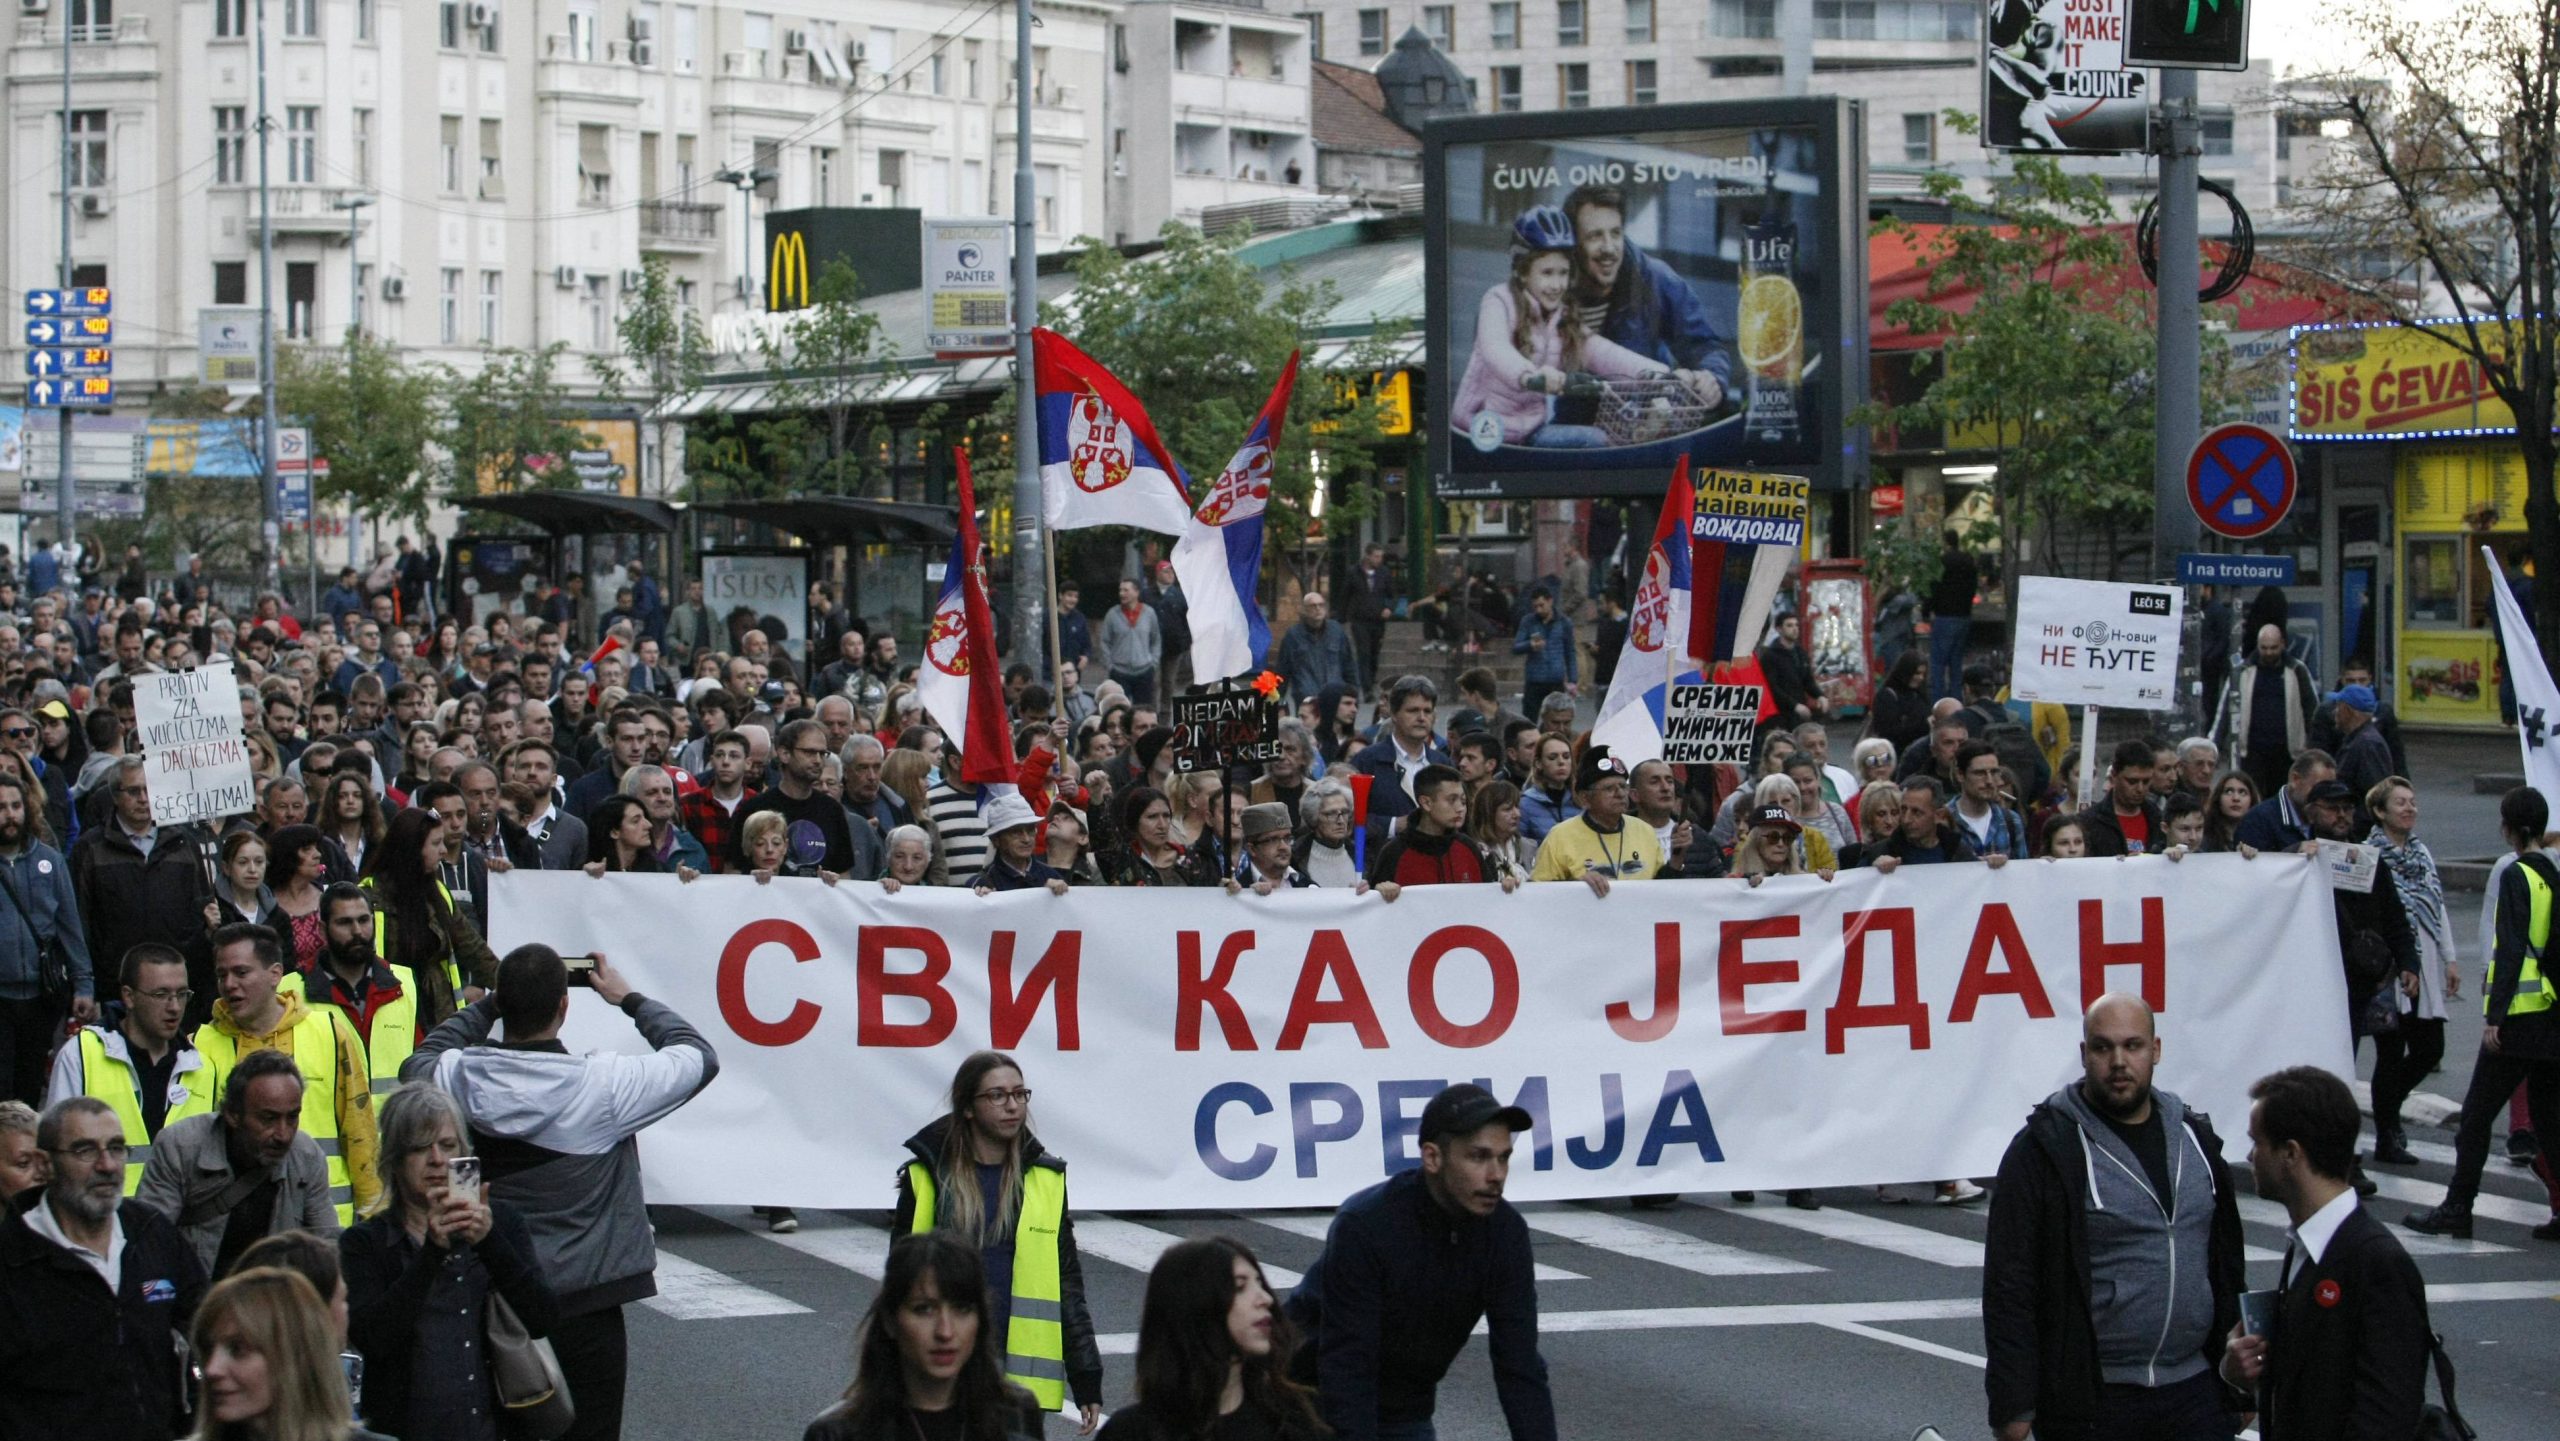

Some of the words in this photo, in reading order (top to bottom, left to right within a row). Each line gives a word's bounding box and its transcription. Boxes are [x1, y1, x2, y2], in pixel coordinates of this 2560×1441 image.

[2064, 15, 2121, 41] MAKE
[2064, 43, 2083, 68] IT
[2064, 70, 2133, 98] COUNT
[1493, 163, 1562, 190] ČUVA
[1568, 163, 1626, 186] ONO
[1748, 236, 1792, 262] Life
[945, 270, 996, 282] PANTER
[87, 288, 110, 305] 152
[84, 318, 110, 334] 400
[85, 349, 109, 365] 321
[84, 379, 111, 394] 098
[1754, 390, 1790, 406] 100%
[2299, 365, 2363, 427] ŠIŠ
[1697, 469, 1753, 495] Има
[1760, 479, 1808, 499] нас
[1692, 516, 1801, 546] ВОЖДОВАЦ
[2187, 560, 2194, 576] I
[2196, 564, 2216, 577] na
[2219, 563, 2284, 579] trotoaru
[711, 574, 798, 599] ISUSA
[2134, 596, 2154, 609] LEČI
[2154, 599, 2166, 610] SE
[2042, 624, 2065, 638] НИ
[2040, 643, 2077, 668] НЕ
[2085, 647, 2156, 673] ЋУТЕ
[158, 671, 209, 699] PROTIV
[173, 696, 201, 720] ZLA
[1671, 685, 1760, 711] СРБИЈА
[1664, 716, 1755, 741] УМИРИТИ
[718, 919, 1082, 1051] СВИ
[1176, 925, 1520, 1051] КАО
[1606, 898, 2168, 1055] ЈЕДАН
